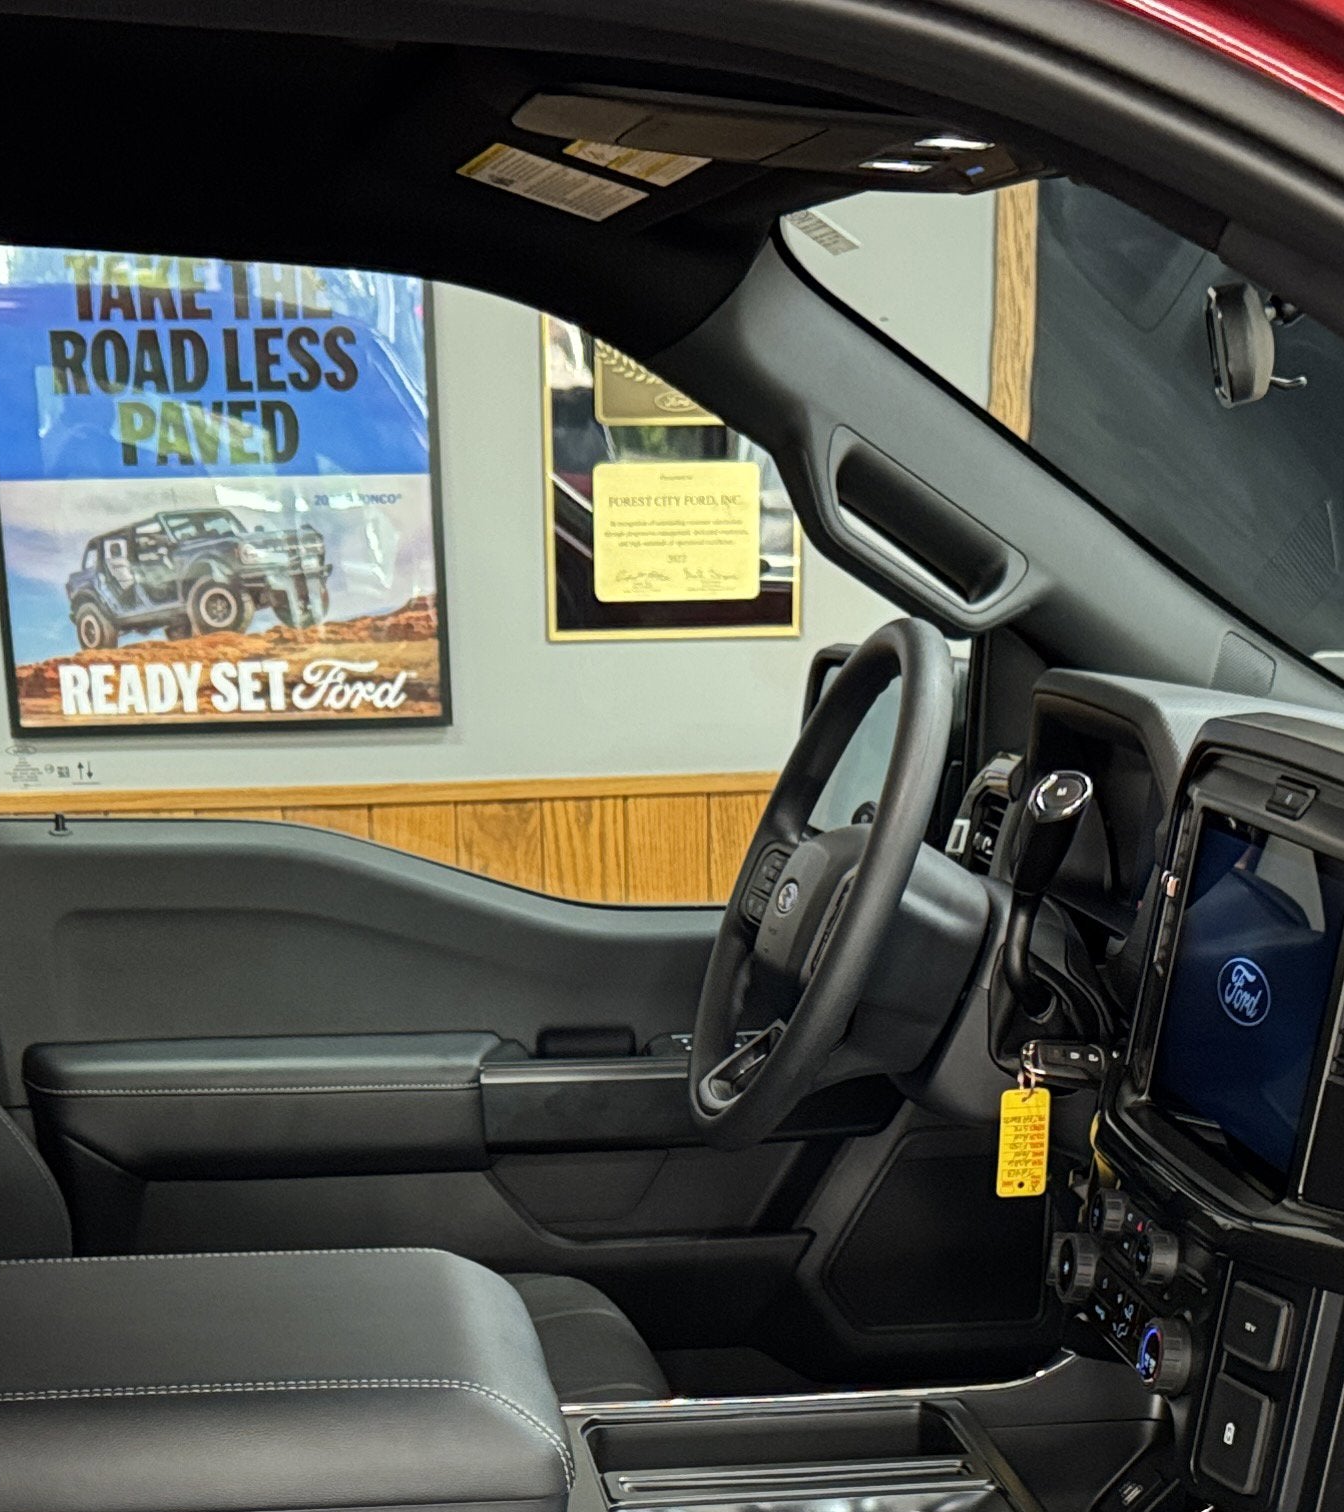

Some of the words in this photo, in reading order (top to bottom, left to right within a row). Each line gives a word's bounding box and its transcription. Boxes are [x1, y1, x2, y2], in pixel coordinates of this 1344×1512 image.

[64, 255, 212, 321] TAKE
[49, 328, 209, 394] ROAD
[223, 326, 359, 392] LESS
[117, 400, 300, 466] PAVED
[608, 496, 652, 507] FOREST
[654, 496, 681, 507] CITY
[58, 661, 203, 716] READY
[210, 660, 290, 713] SET
[292, 658, 408, 711] Ford
[1224, 964, 1263, 1019] Ford
